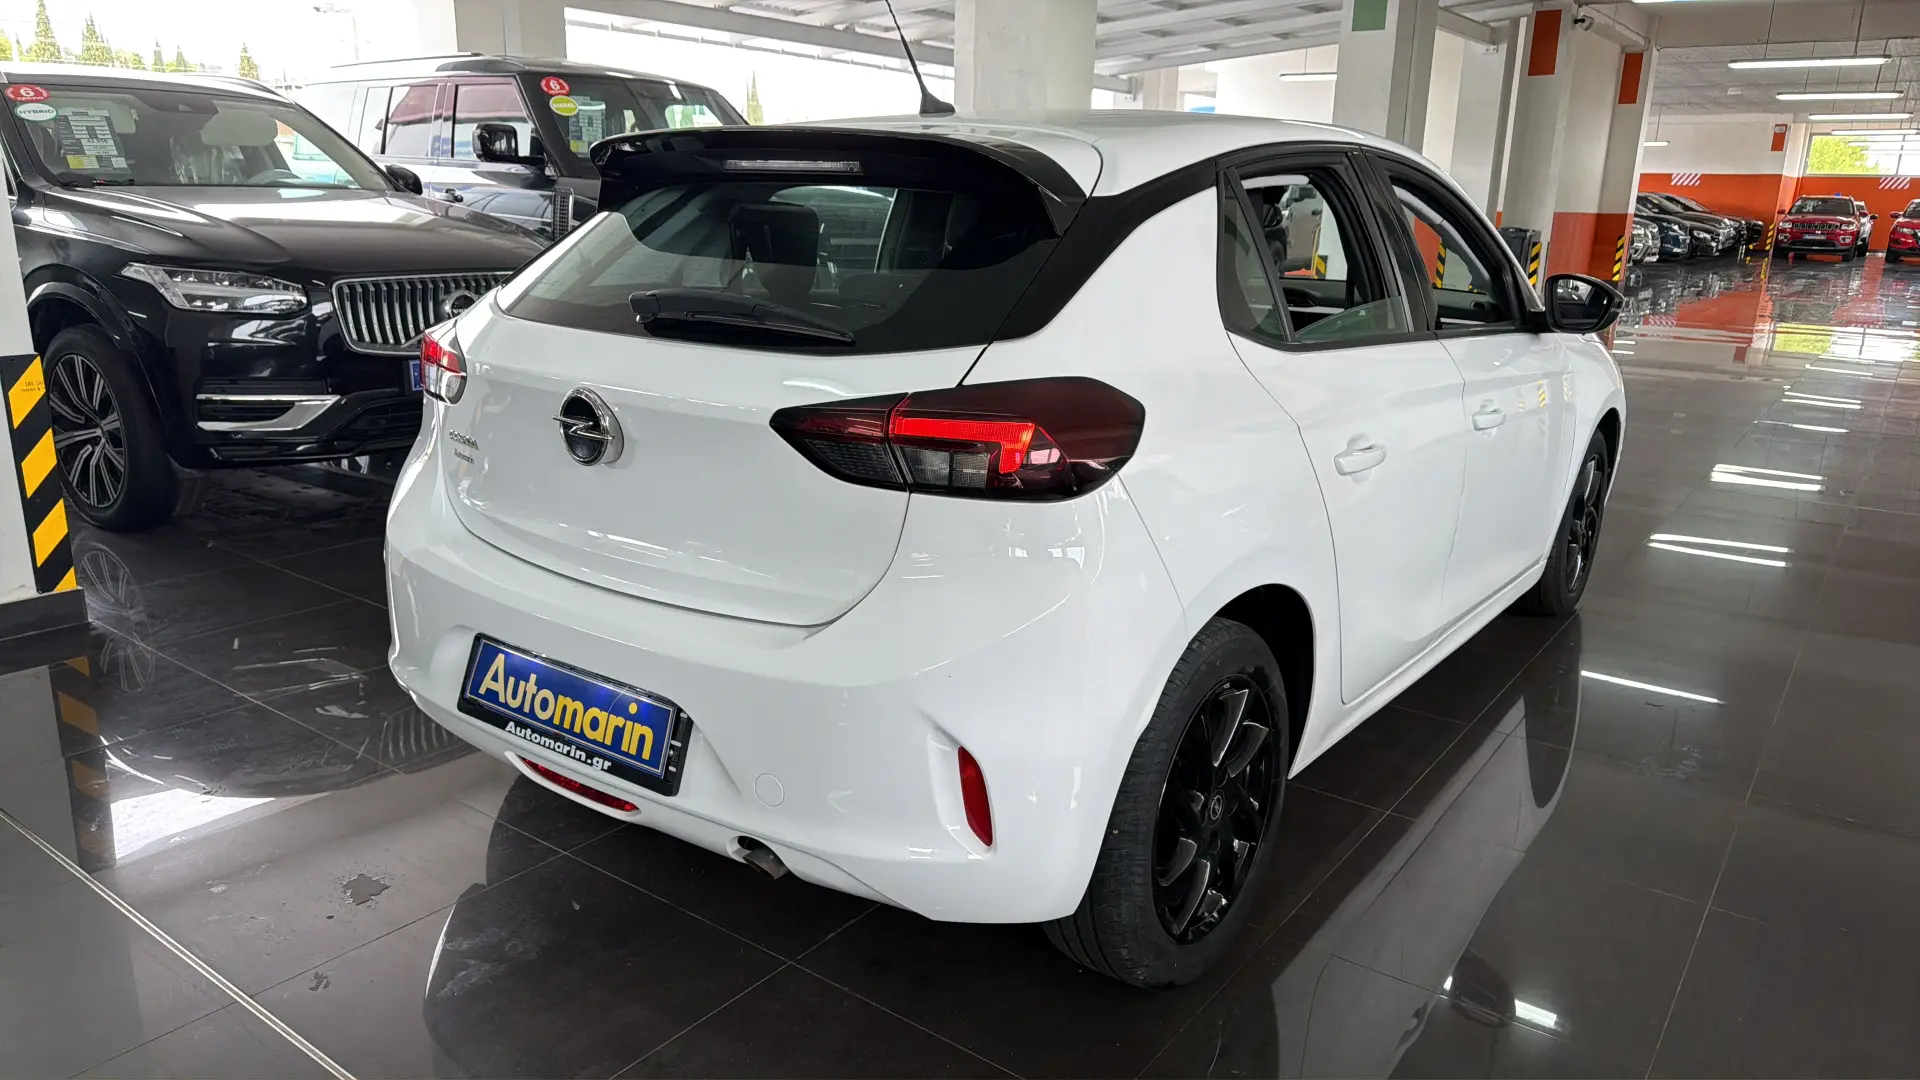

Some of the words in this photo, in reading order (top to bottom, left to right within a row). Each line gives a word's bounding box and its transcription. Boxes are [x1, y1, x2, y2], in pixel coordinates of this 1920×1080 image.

[20, 86, 35, 97] 6
[478, 652, 654, 761] Automarin
[504, 721, 612, 771] Automarin.gr
